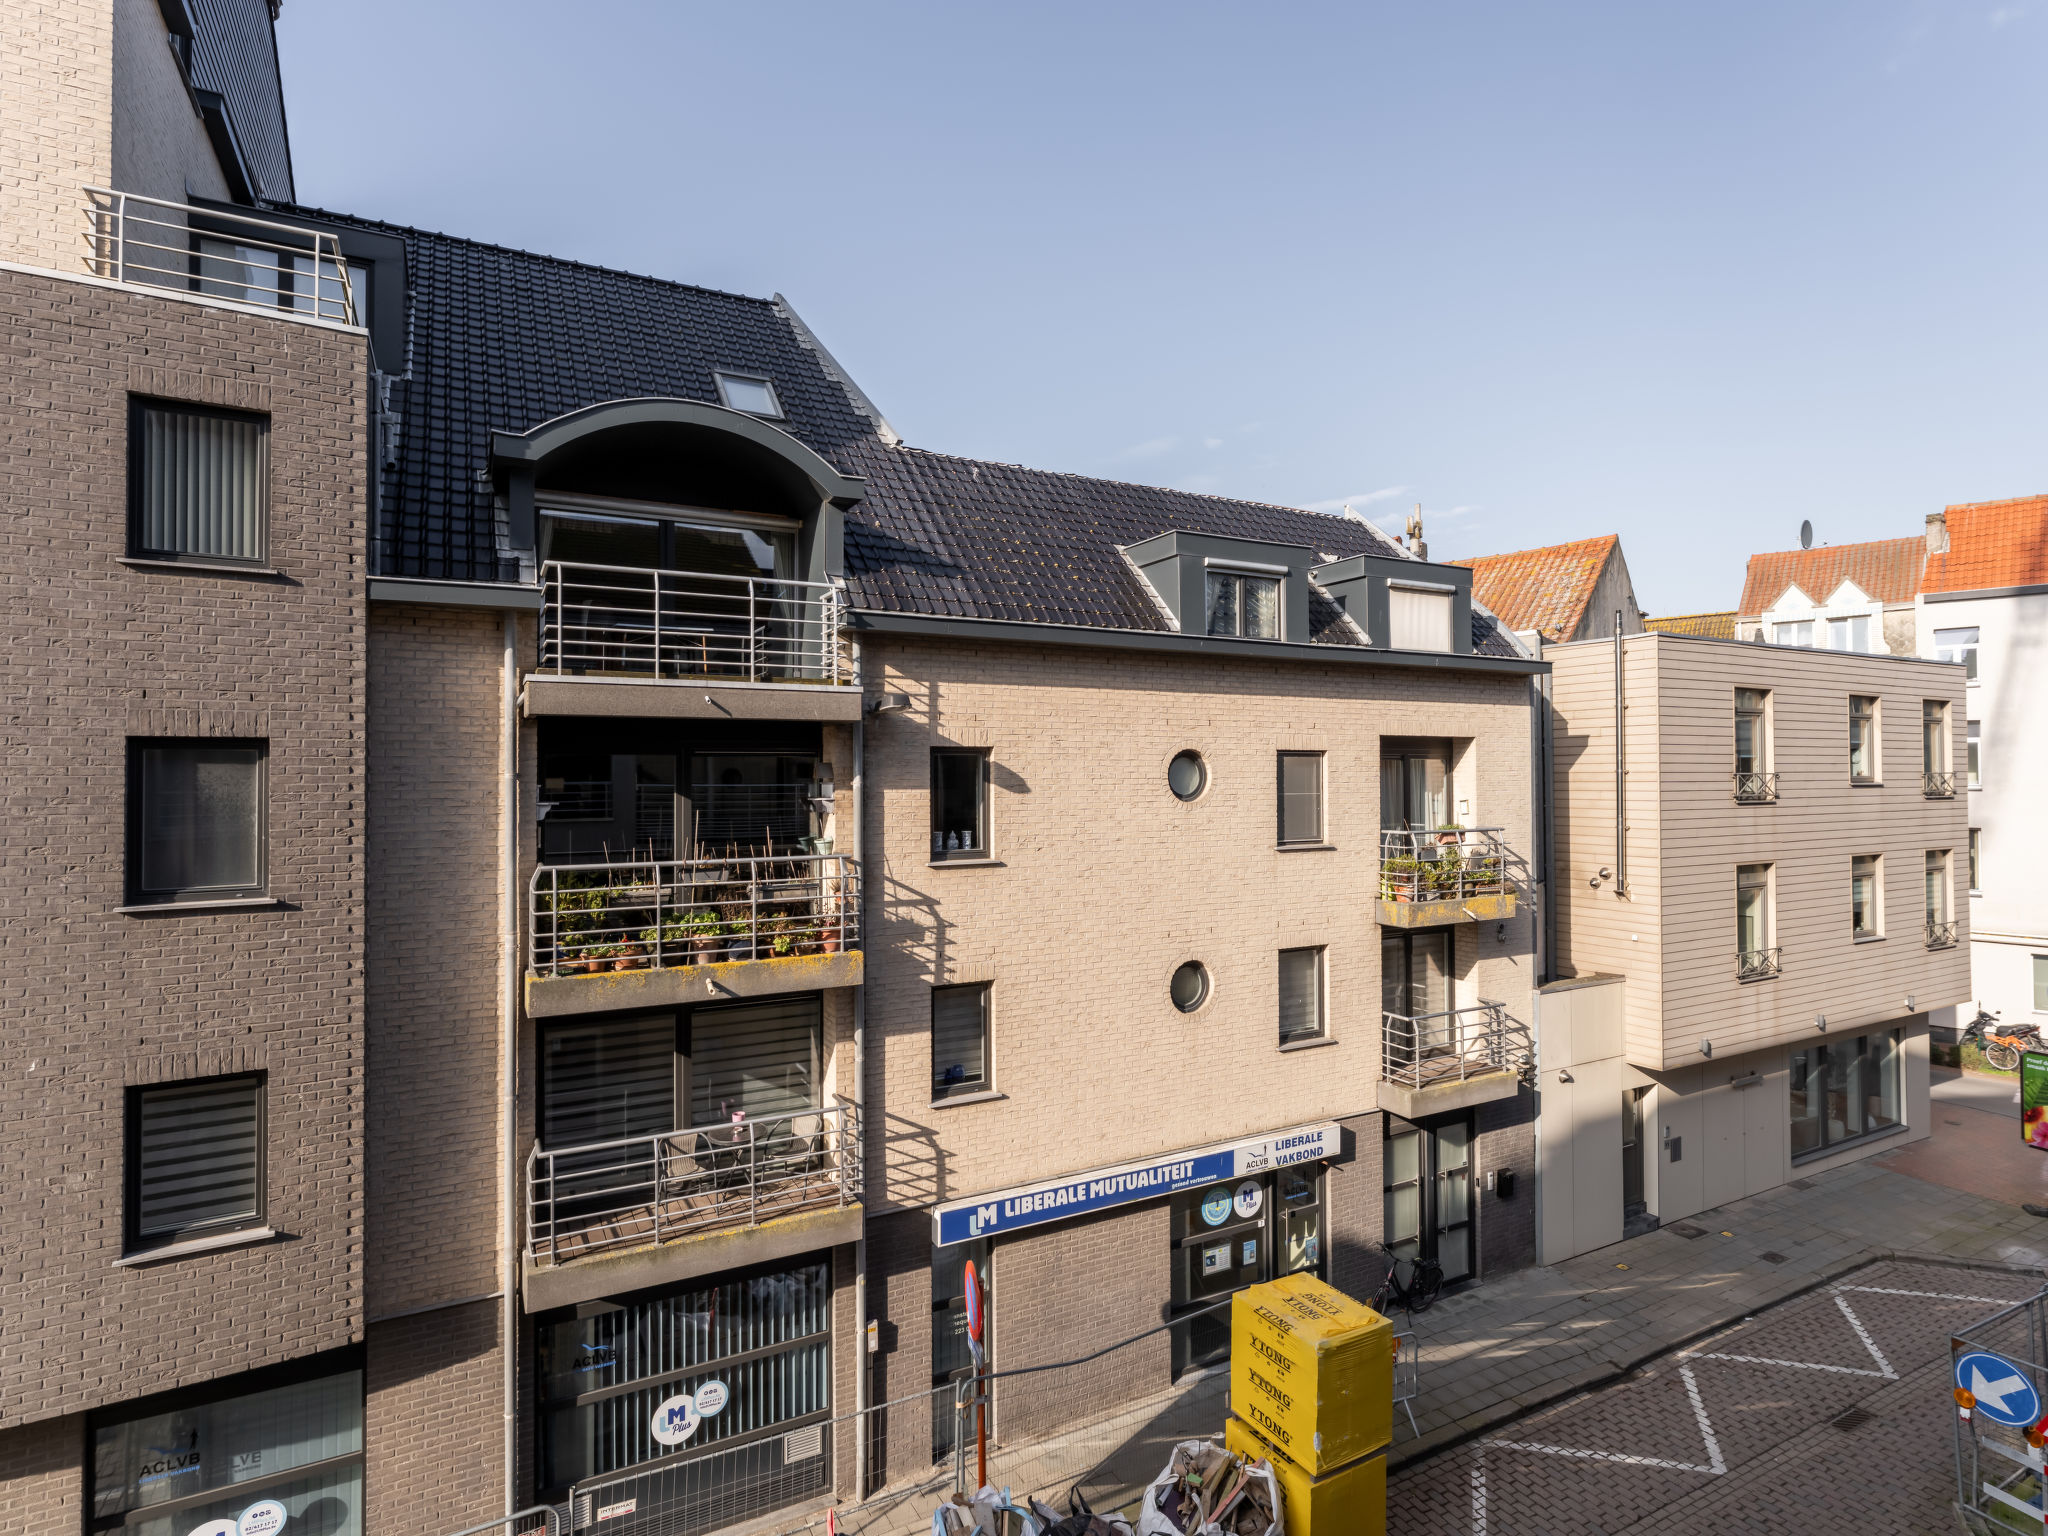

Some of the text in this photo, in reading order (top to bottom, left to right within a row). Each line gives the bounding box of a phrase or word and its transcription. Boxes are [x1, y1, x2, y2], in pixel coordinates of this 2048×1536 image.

[1275, 1131, 1323, 1151] LIBERALE
[1246, 1157, 1269, 1170] ACLVB
[1275, 1146, 1324, 1165] VAKBOND
[1004, 1183, 1086, 1218] LIBERALE
[1089, 1160, 1194, 1199] MUTUALITEIT
[1286, 1296, 1322, 1320] YTONG
[1302, 1292, 1341, 1316] YTONG
[1256, 1305, 1294, 1333] YTONG
[1251, 1335, 1291, 1370] YTONG
[1249, 1367, 1291, 1408] YTONG
[672, 1421, 692, 1436] Plus
[1249, 1402, 1290, 1444] YTONG
[139, 1452, 200, 1478] ACLVB
[600, 1501, 634, 1515] INTERMAT
